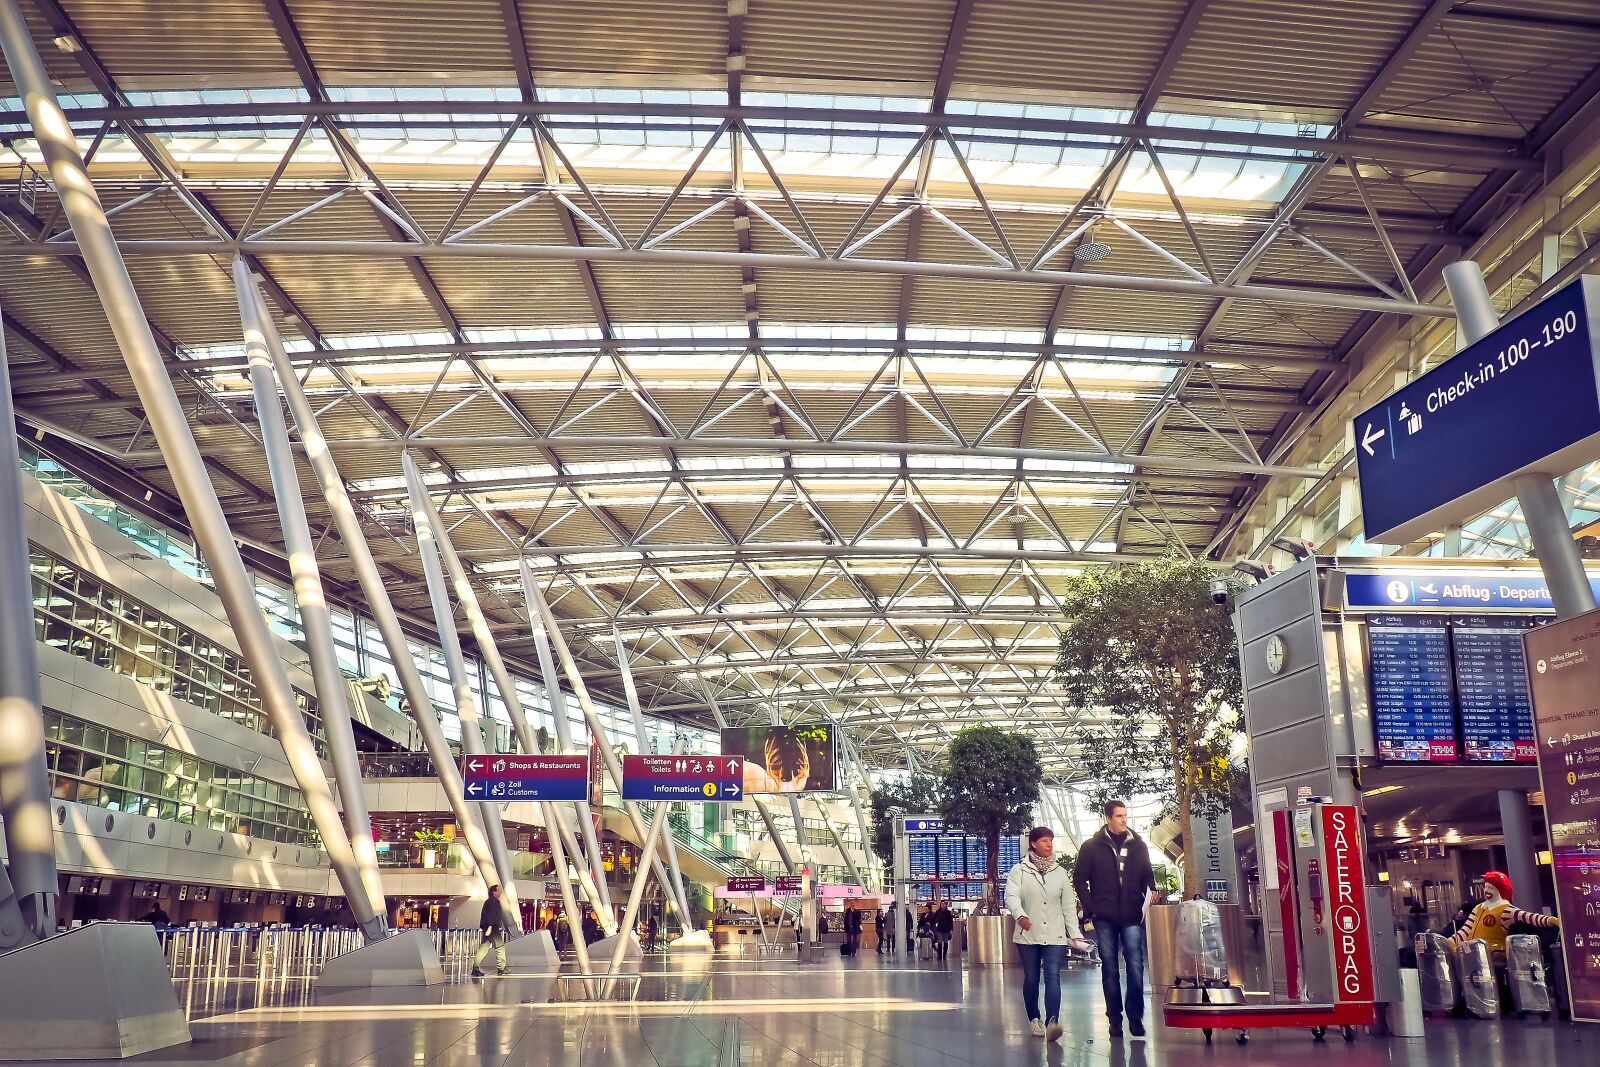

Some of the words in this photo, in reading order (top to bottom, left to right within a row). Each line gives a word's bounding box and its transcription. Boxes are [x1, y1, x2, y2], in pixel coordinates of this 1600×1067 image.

[1426, 362, 1495, 413] Check-in
[1442, 584, 1490, 602] Abflug
[1550, 654, 1565, 662] Abflug
[1564, 651, 1580, 659] Ebene
[1572, 733, 1588, 741] Shops
[509, 762, 532, 770] Shops
[508, 780, 522, 788] Zoll
[653, 784, 700, 793] Information
[507, 788, 539, 796] Customs
[1579, 788, 1590, 796] Zoll
[1332, 812, 1354, 903] SAFER
[1342, 935, 1360, 994] BAG
